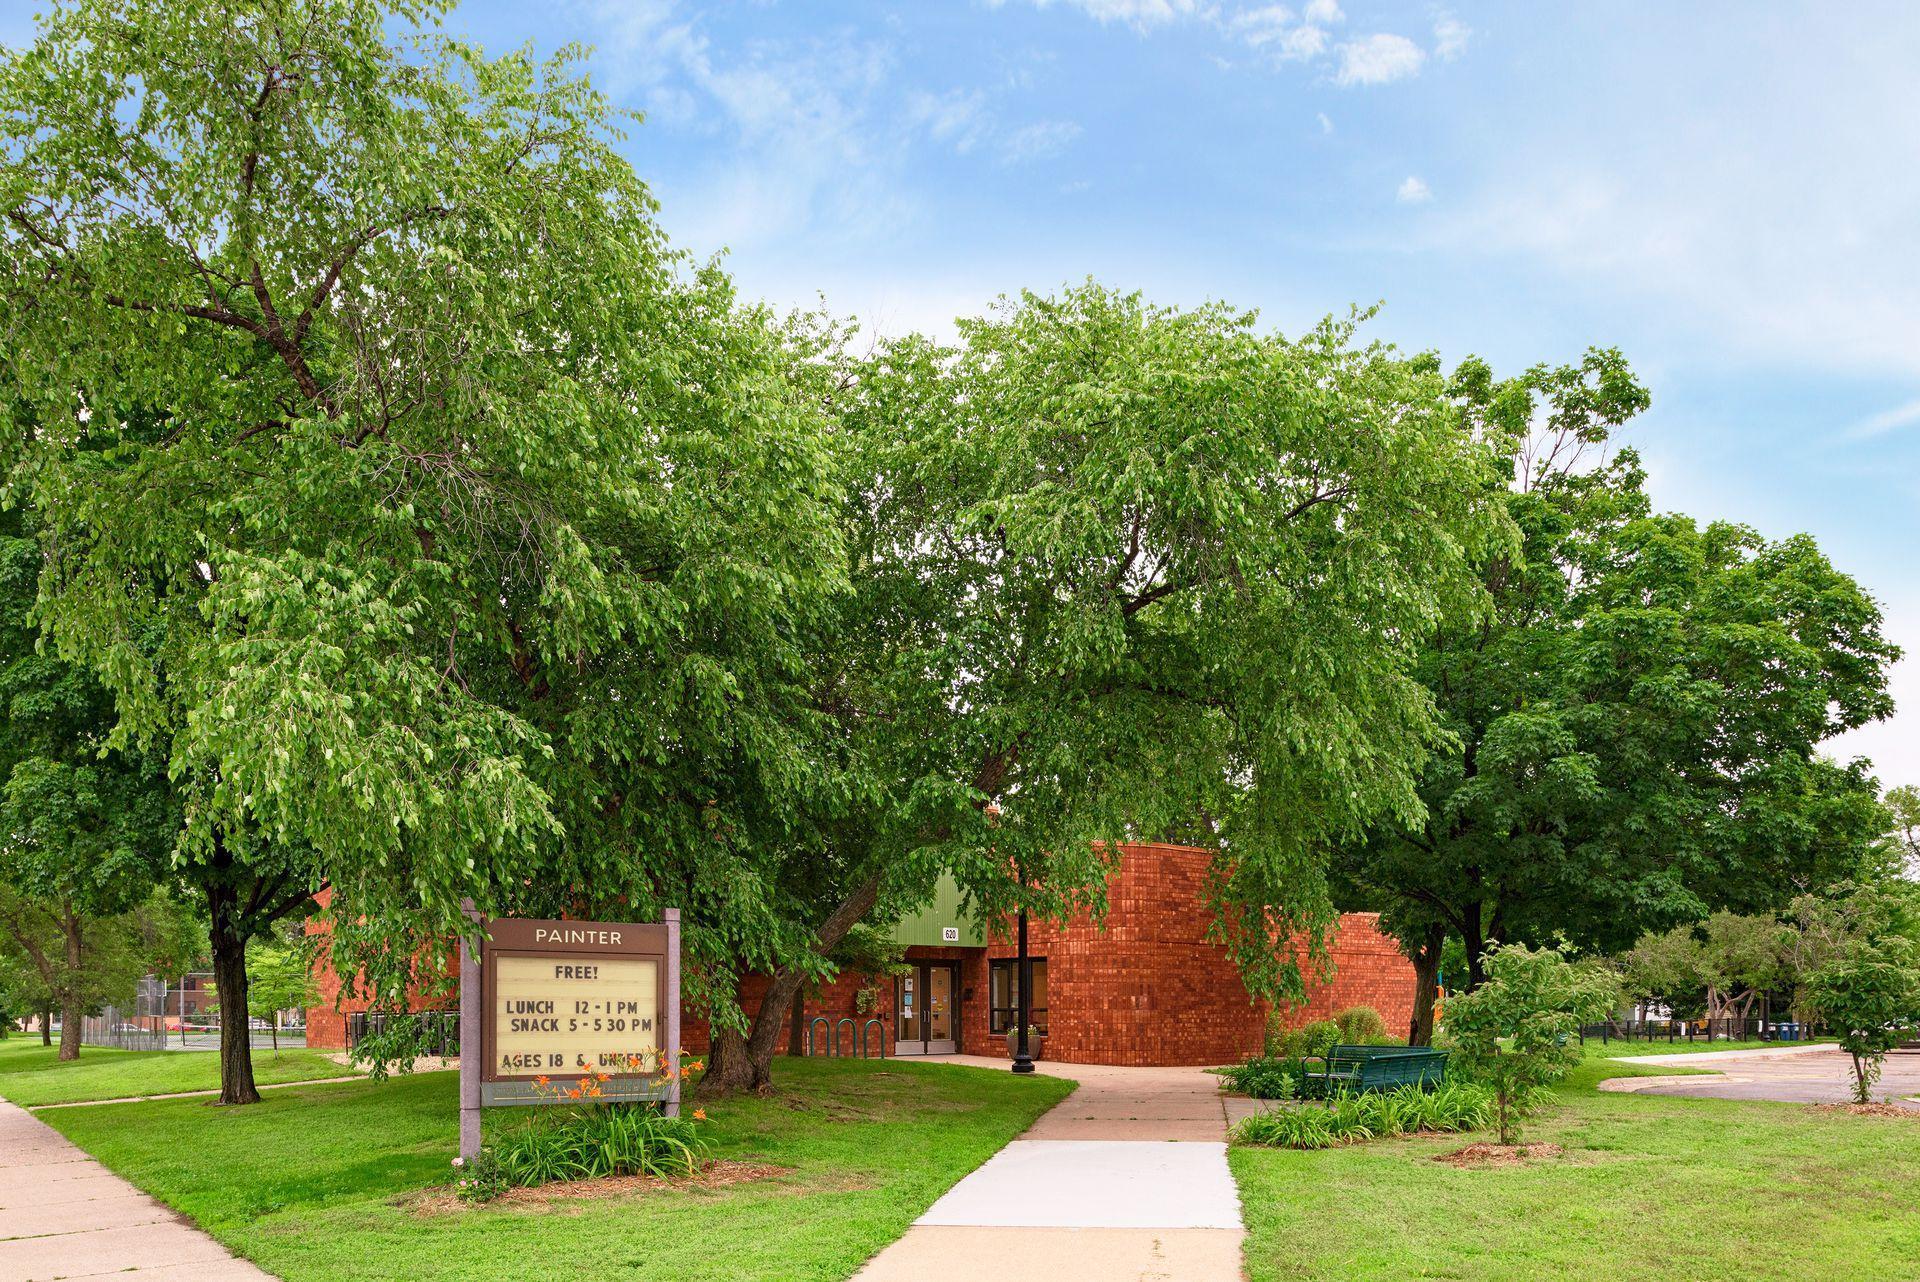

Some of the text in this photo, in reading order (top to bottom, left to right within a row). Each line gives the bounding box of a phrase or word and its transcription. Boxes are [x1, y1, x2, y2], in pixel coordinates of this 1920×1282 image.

[535, 928, 622, 945] PAINTER
[945, 929, 957, 939] 620
[555, 965, 599, 979] FREE!
[506, 1000, 554, 1015] LUNCH
[575, 1001, 589, 1014] 12
[606, 1001, 611, 1014] 1
[617, 1001, 638, 1014] PM
[511, 1018, 559, 1032] SNACK
[569, 1018, 578, 1031] 5
[632, 1018, 652, 1031] PM
[502, 1053, 542, 1068] AGES
[549, 1053, 564, 1067] 18
[576, 1053, 586, 1067] &
